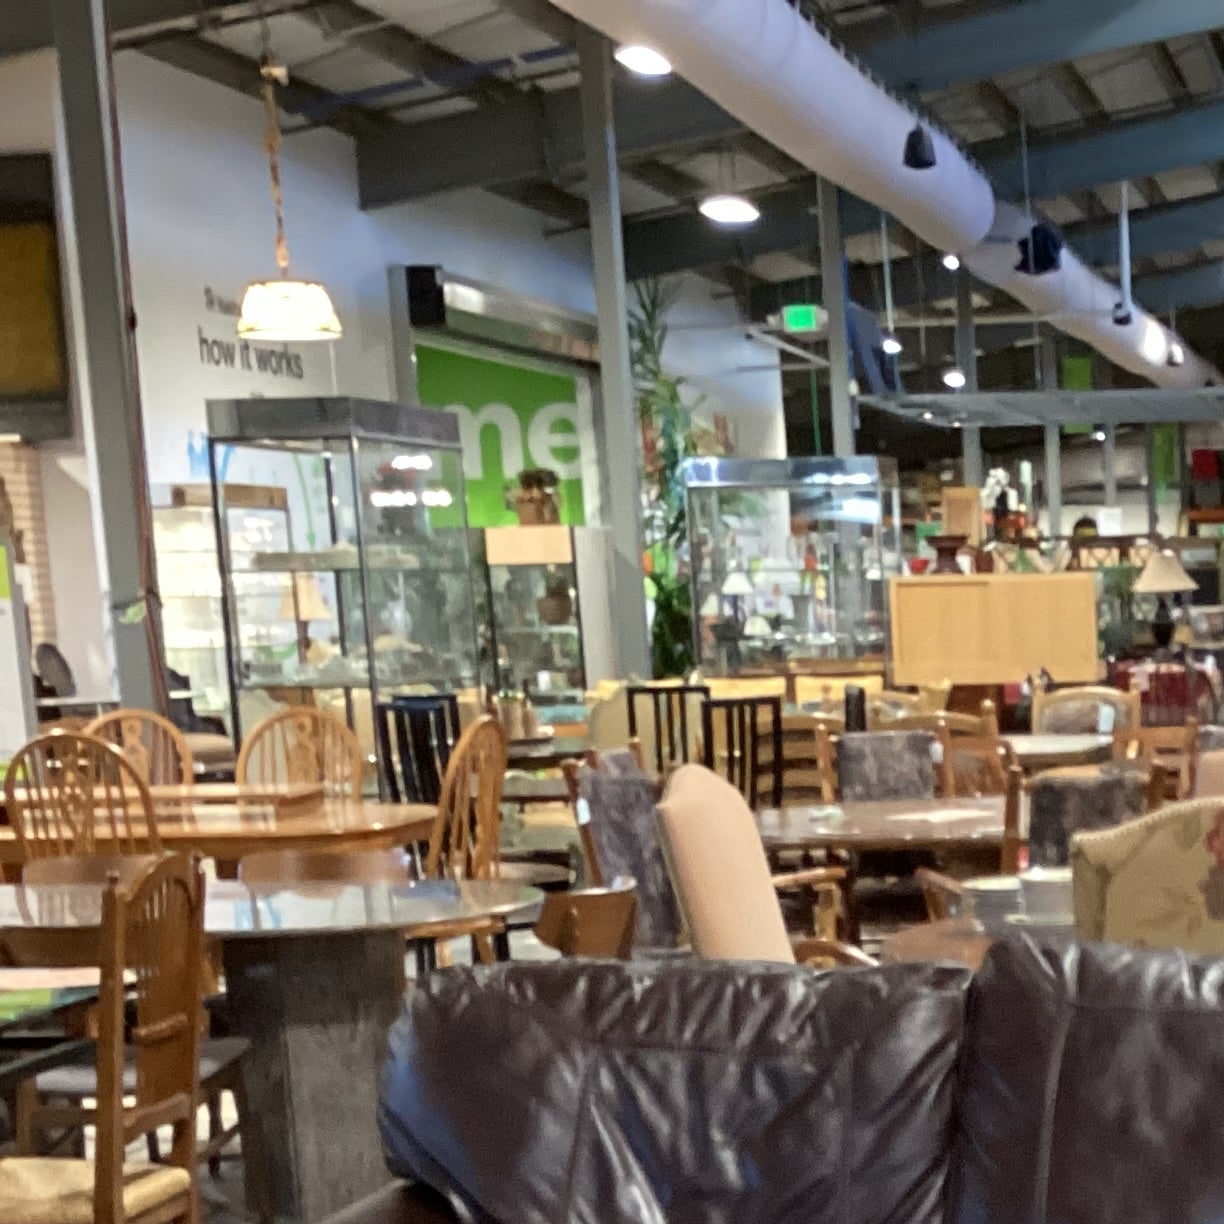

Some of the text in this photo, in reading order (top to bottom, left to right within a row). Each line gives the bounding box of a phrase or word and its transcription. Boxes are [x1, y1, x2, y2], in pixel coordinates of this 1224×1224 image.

[197, 325, 304, 379] how it works
